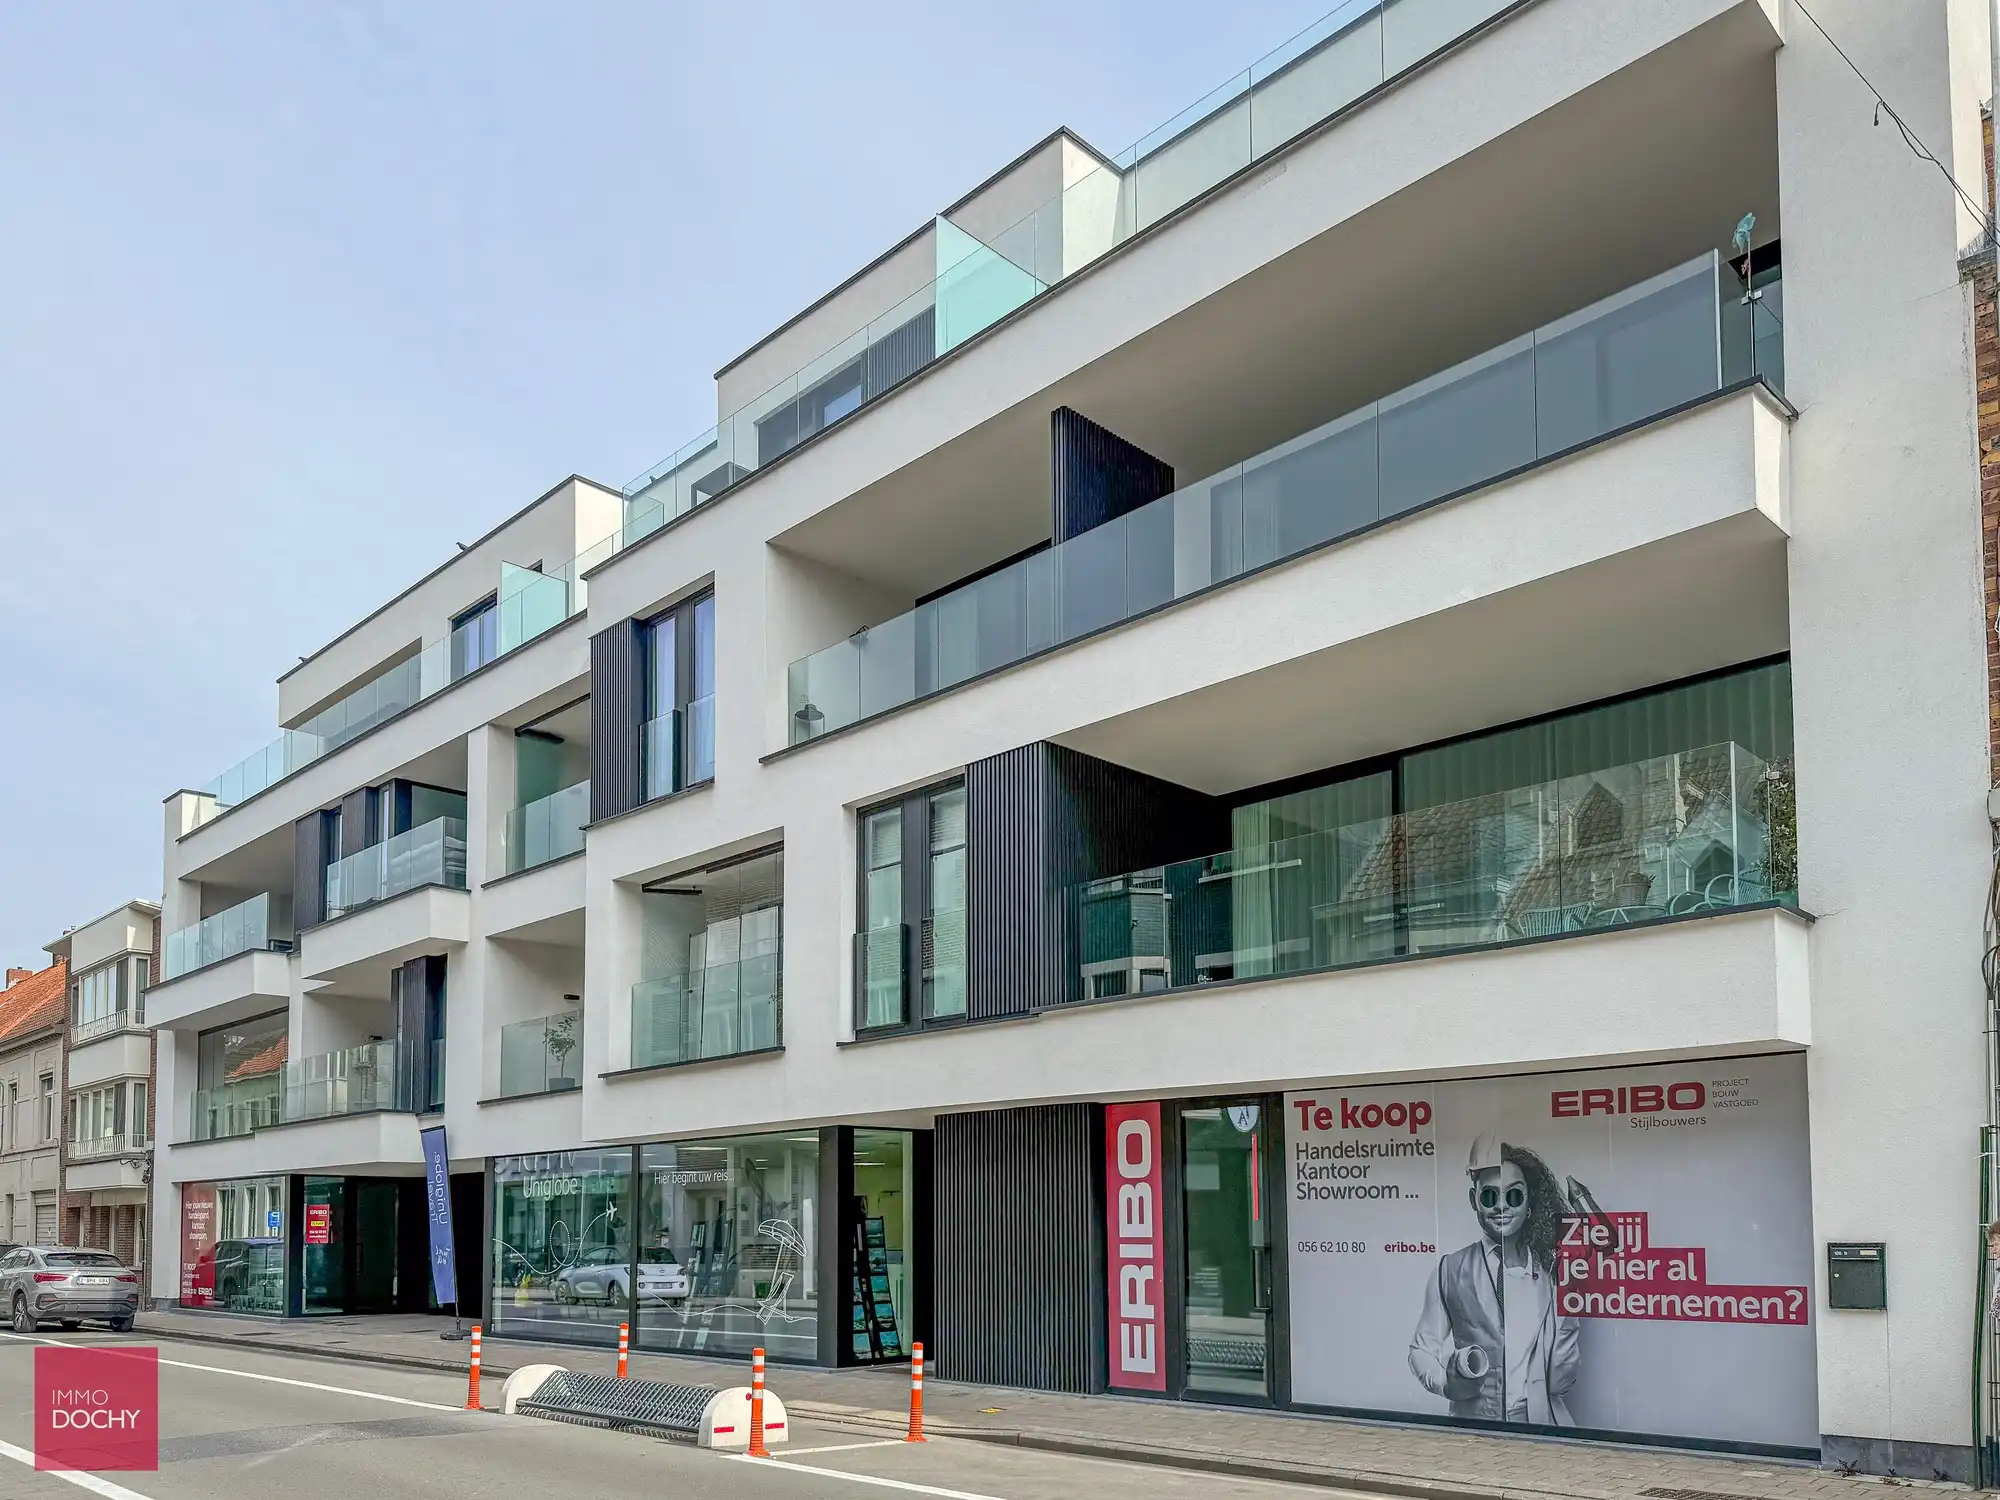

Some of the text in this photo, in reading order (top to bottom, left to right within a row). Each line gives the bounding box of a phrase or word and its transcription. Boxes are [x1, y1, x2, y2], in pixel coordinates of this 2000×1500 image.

[1711, 1078, 1749, 1088] PROJECT
[1551, 1081, 1706, 1118] ERIBO
[1711, 1089, 1739, 1098] BOUW
[1712, 1098, 1759, 1108] VASTGOED
[1293, 1097, 1432, 1135] Te koop
[1630, 1116, 1707, 1131] Stijlbouwers
[1295, 1138, 1435, 1160] Handelsruimte
[654, 1171, 670, 1185] Hier
[672, 1171, 697, 1186] begint
[698, 1171, 712, 1183] uw
[1296, 1161, 1371, 1180] Kantoor
[1296, 1181, 1400, 1201] Showroom
[1561, 1217, 1642, 1253] Zie jij
[1117, 1119, 1156, 1374] ERIBO
[1297, 1241, 1436, 1253] 056 62 10 80 eribo.be
[1559, 1251, 1698, 1286] je hier al
[198, 1287, 213, 1296] ERIBO
[1563, 1286, 1804, 1320] ondernemen?
